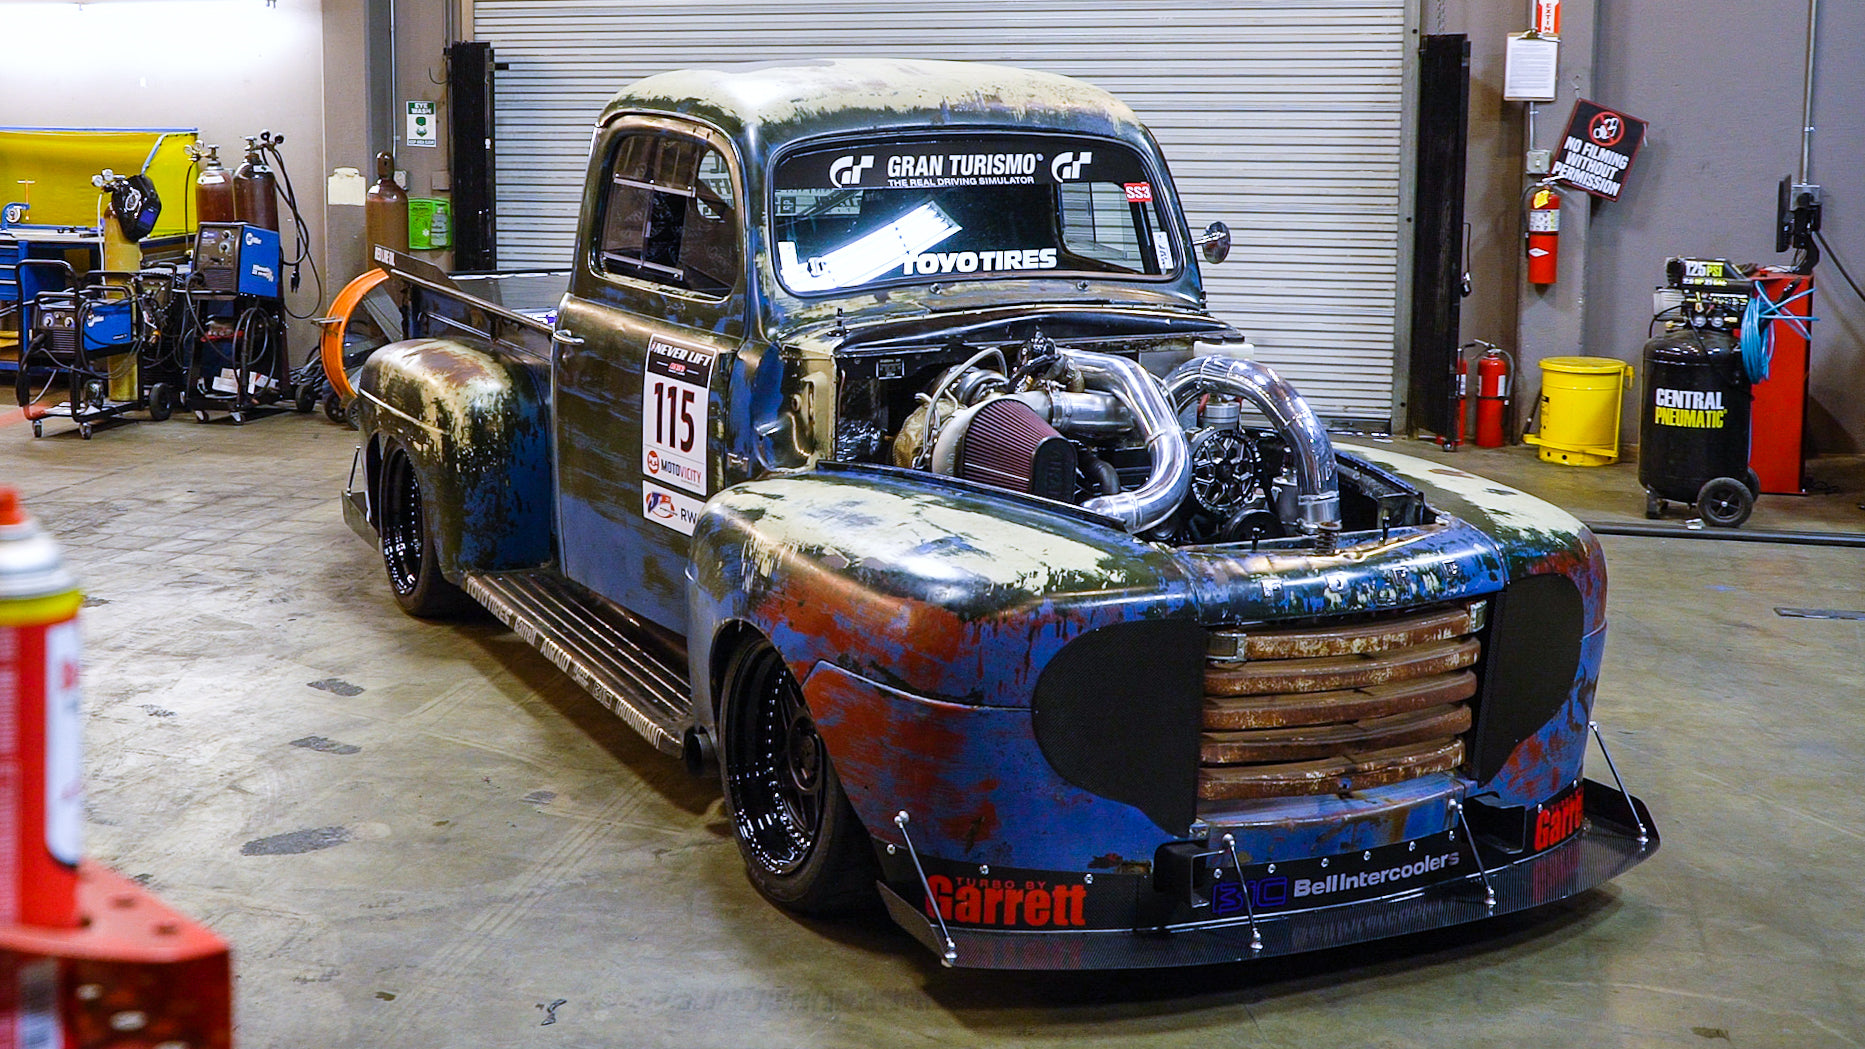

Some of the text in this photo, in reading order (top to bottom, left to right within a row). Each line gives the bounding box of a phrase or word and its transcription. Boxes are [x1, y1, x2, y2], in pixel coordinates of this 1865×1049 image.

[1564, 136, 1629, 170] NO FILMING
[887, 155, 944, 177] GRAN
[1565, 151, 1619, 179] WITHOUT
[888, 176, 1035, 187] THE REAL DRIVING SIMULATOR
[1551, 161, 1621, 196] PERMISSION
[1125, 186, 1151, 199] SS3
[1685, 261, 1723, 277] 125 PSI
[687, 351, 712, 367] LIFT
[1655, 388, 1725, 410] CENTRAL
[654, 382, 695, 453] 115
[661, 459, 701, 484] MOTOVICITY
[955, 877, 1047, 890] TURBO BY
[925, 875, 1087, 926] Garrett
